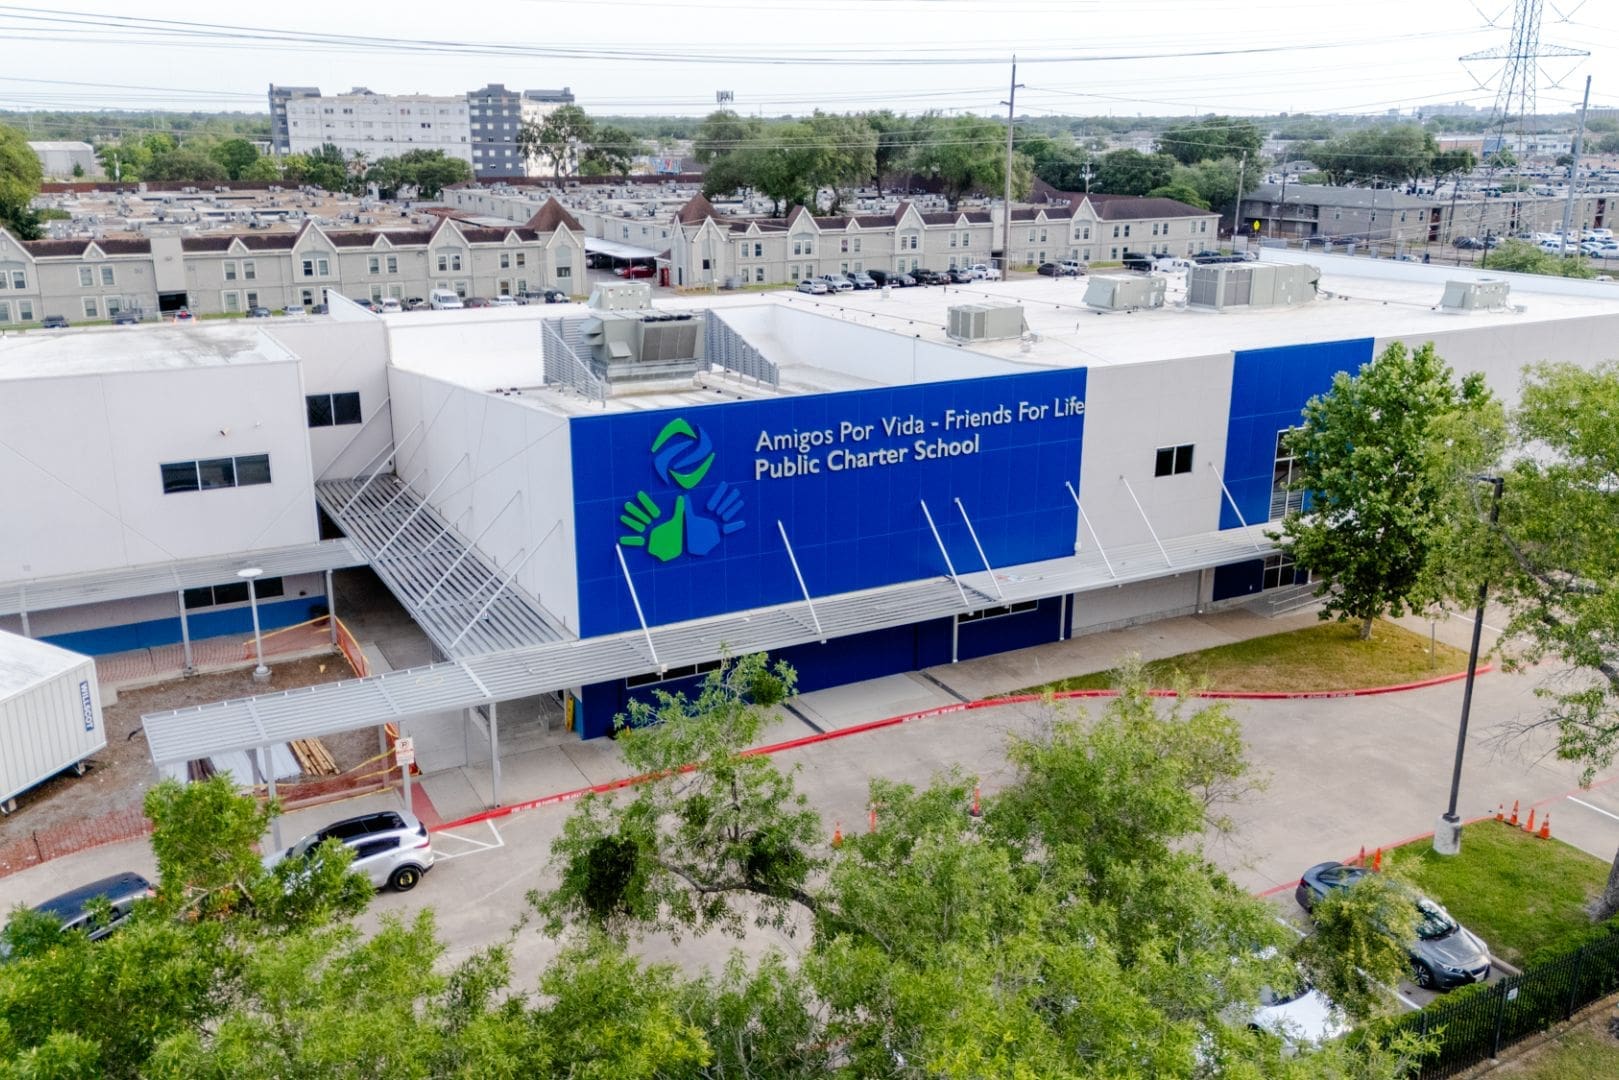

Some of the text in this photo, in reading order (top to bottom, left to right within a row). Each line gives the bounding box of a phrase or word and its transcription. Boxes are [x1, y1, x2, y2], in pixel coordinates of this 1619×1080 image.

[755, 428, 833, 453] Amigos
[840, 421, 874, 443] Por
[882, 414, 925, 437] Vida
[945, 404, 1012, 431] Friends
[1018, 401, 1049, 422] For
[1054, 396, 1085, 417] Life
[755, 433, 979, 481] Public Charter School
[81, 682, 93, 728] WILLSCOT
